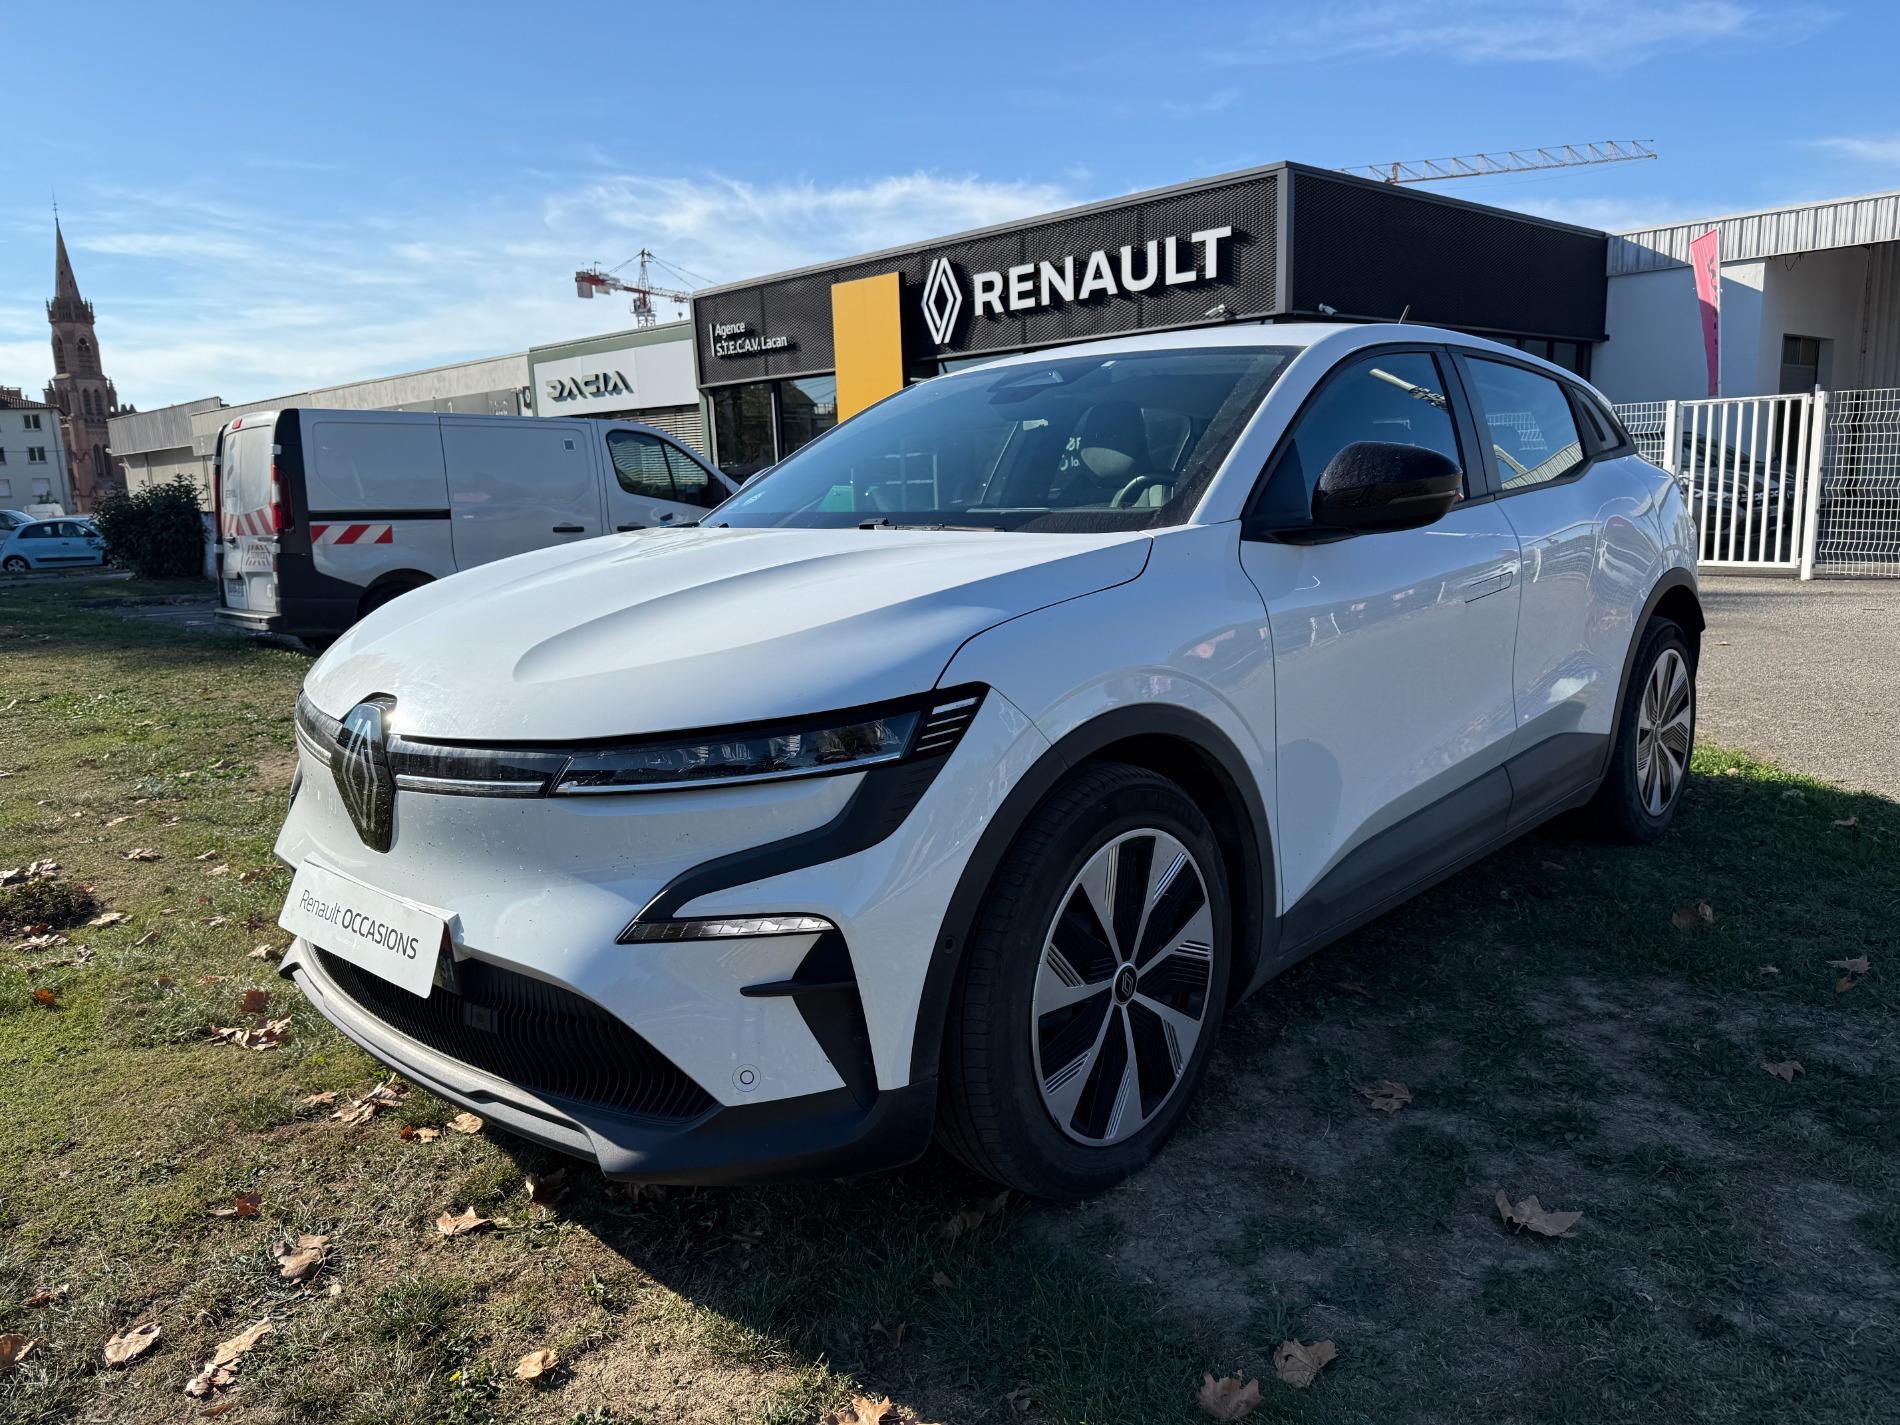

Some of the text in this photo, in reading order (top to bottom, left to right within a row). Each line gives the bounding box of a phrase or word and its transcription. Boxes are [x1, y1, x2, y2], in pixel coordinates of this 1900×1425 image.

[973, 226, 1232, 316] RENAULT
[715, 322, 746, 338] Agence
[761, 336, 788, 350] Lacan
[545, 370, 633, 401] DACIA
[300, 889, 419, 960] Renault OCCASIONS
